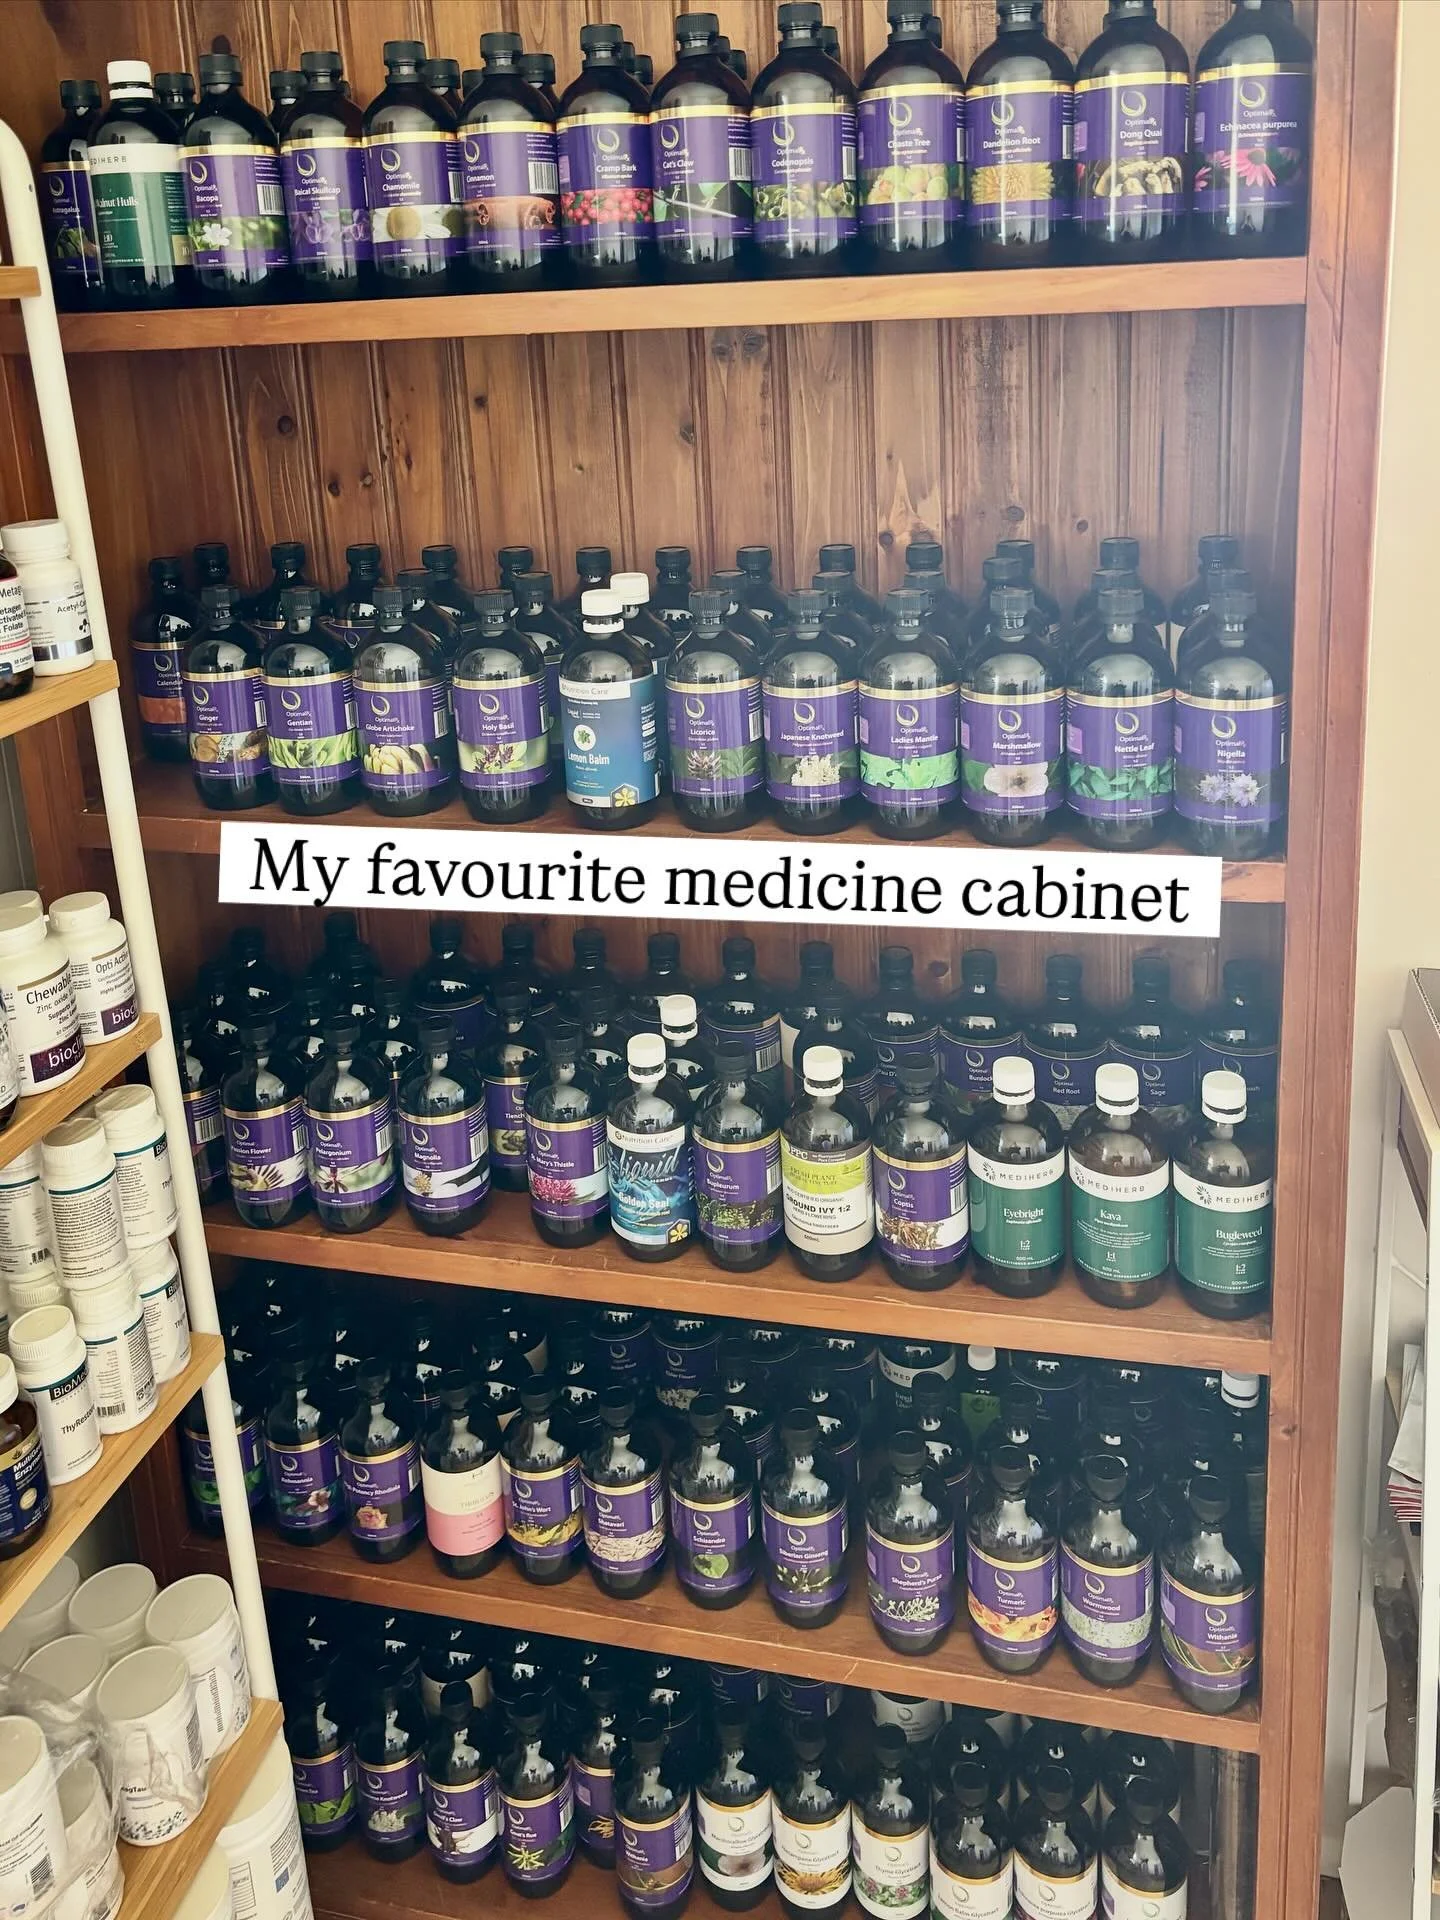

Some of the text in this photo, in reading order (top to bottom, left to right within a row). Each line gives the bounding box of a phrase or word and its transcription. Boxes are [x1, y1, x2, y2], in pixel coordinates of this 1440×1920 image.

[1120, 128, 1163, 139] Dong Quai
[914, 138, 930, 146] Tree
[983, 136, 1040, 148] Dandelion Root
[663, 159, 693, 168] Cat's Claw
[772, 157, 813, 167] Codonopsis
[596, 163, 637, 174] Cramp Bark
[467, 173, 495, 182] Cinnamon
[294, 186, 340, 195] Baical Skullcap
[383, 182, 420, 191] Chamomile
[196, 194, 219, 202] Bacopa
[0, 604, 21, 615] etagen
[0, 610, 26, 623] ctivated
[4, 622, 23, 632] Folate
[199, 714, 218, 722] Ginger
[382, 724, 415, 732] Artichoke
[482, 722, 514, 732] Holy Basil
[780, 730, 844, 740] Japanese Knotweed
[891, 734, 938, 744] Ladies Mantle
[992, 741, 1041, 750] Marshmallow
[1115, 743, 1155, 752] Nettle Leaf
[568, 752, 610, 765] Lemon Balm
[1217, 750, 1245, 759] Nigella
[96, 962, 113, 973] Opti
[36, 1003, 52, 1014] Zinc
[1053, 1086, 1064, 1094] Red
[252, 1146, 271, 1154] Flower
[554, 1160, 574, 1168] Thistle
[999, 1169, 1054, 1181] MEDIHERB
[1088, 1179, 1145, 1193] MEDIHERB
[618, 1192, 647, 1208] Golden
[1216, 1190, 1271, 1204] MEDIHERB
[894, 1198, 914, 1208] Coptis
[1004, 1207, 1044, 1218] Eyebright
[1100, 1210, 1121, 1221] Kava
[1216, 1227, 1262, 1240] Bugleweed
[779, 1550, 803, 1559] Siberian
[892, 1574, 942, 1586] Shepherd's Purse
[997, 1596, 1026, 1606] Turmeric
[1082, 1597, 1121, 1612] Wormwood
[1208, 1632, 1238, 1640] Withania
